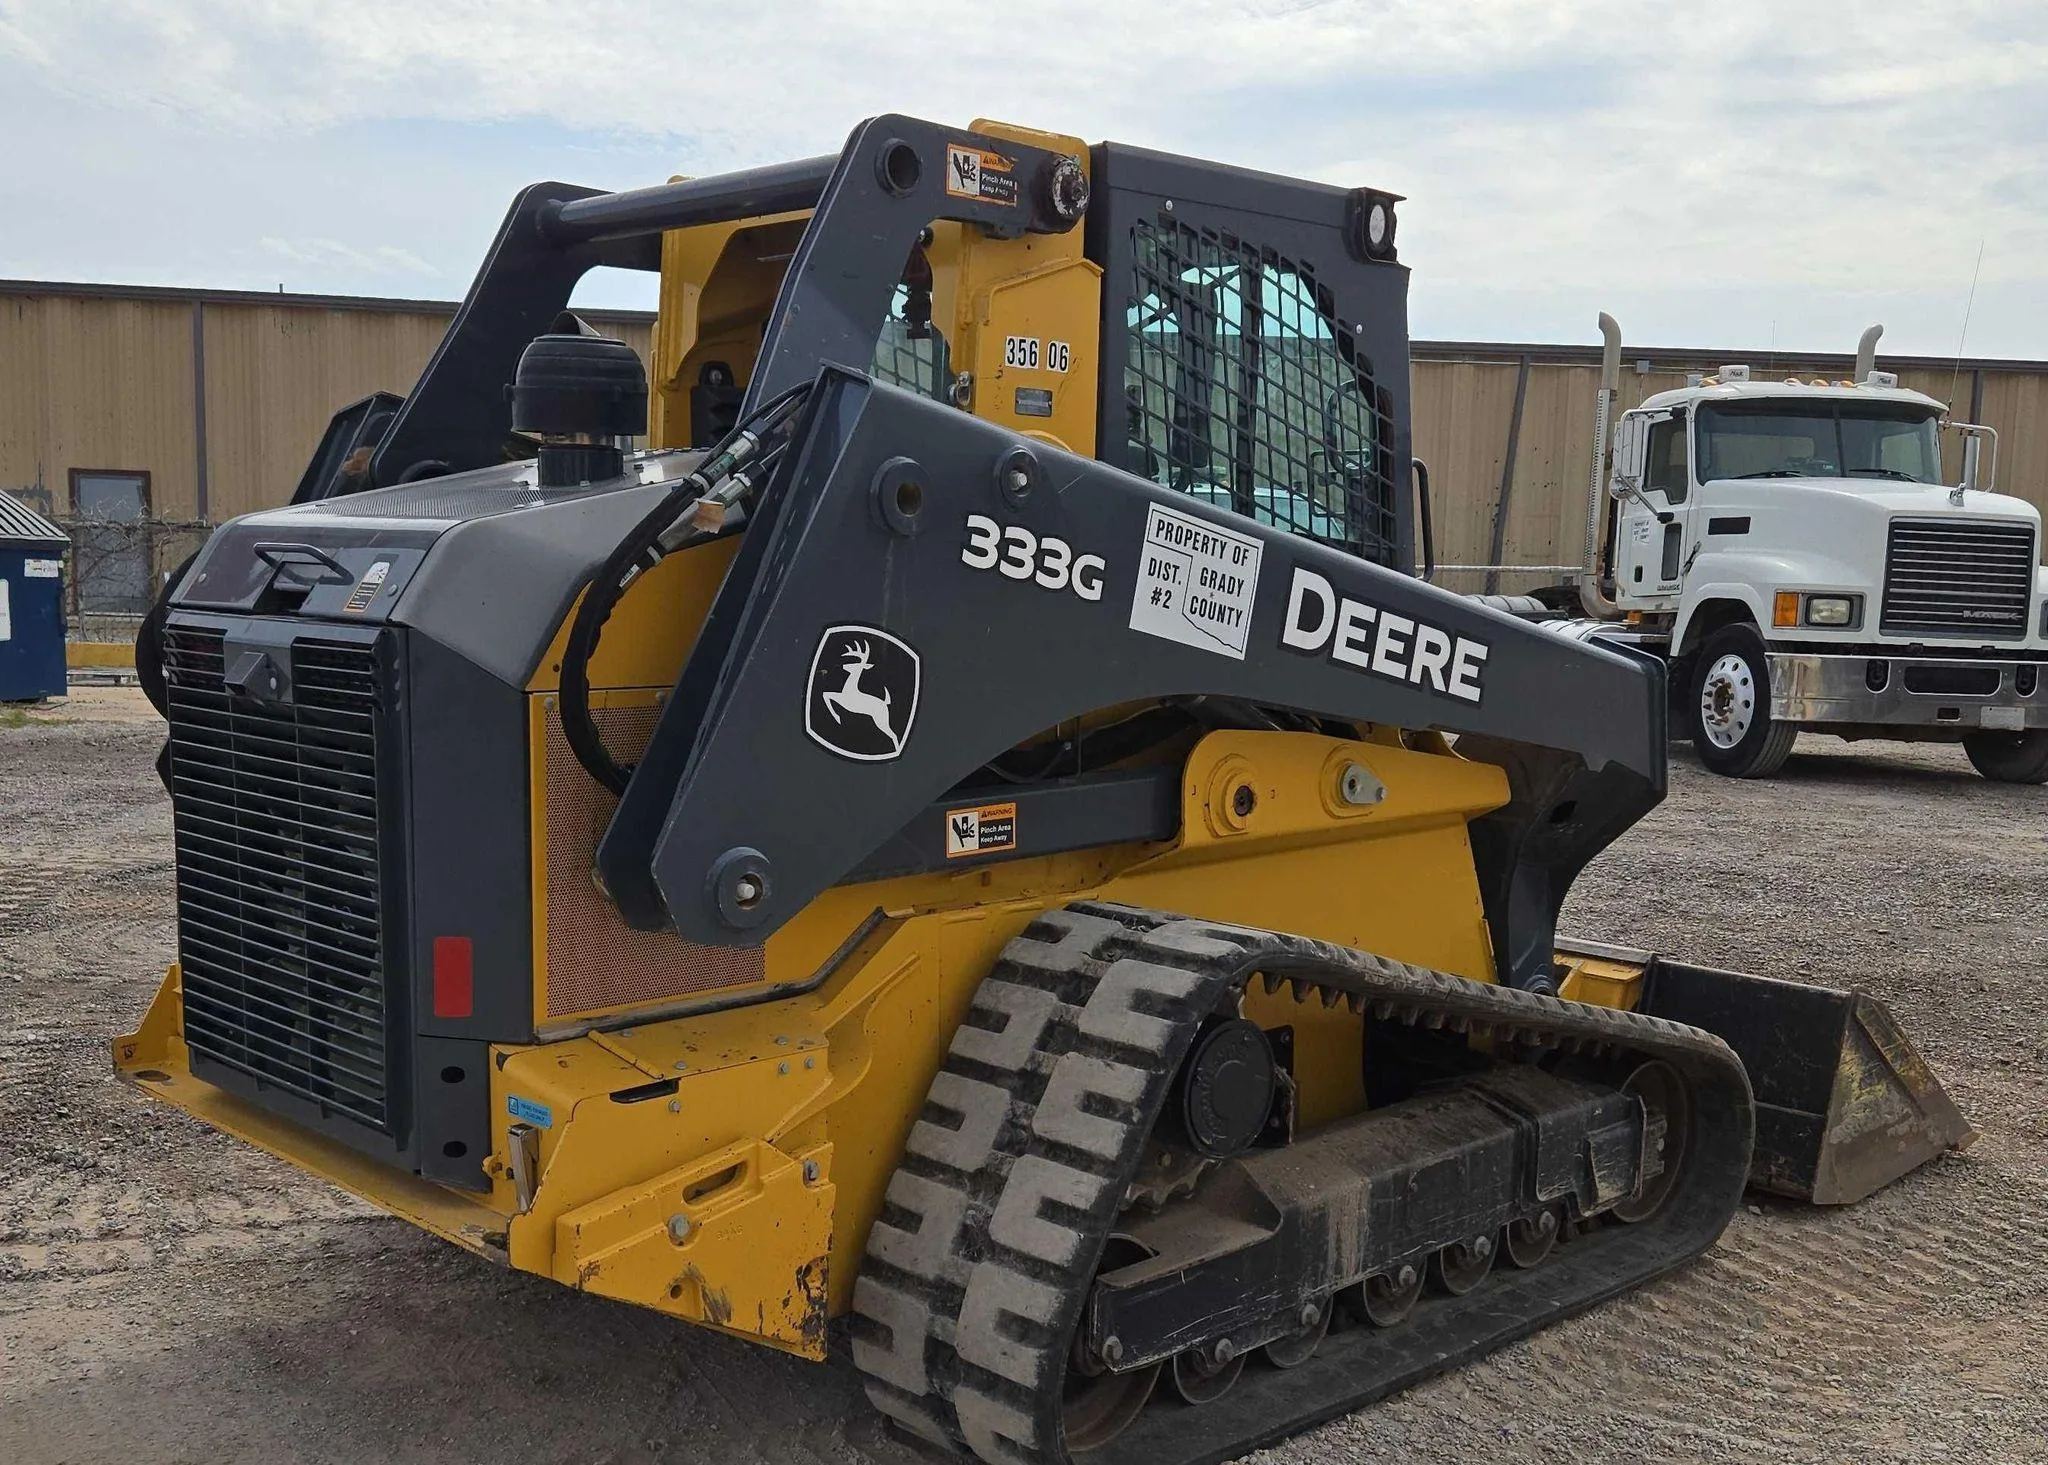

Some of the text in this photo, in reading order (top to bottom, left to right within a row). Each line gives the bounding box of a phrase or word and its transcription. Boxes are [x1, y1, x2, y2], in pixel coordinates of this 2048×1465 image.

[1007, 338, 1068, 371] 356 06
[962, 514, 1105, 601] 333G
[1155, 518, 1249, 567] PROPERTY OF
[1147, 557, 1245, 598] DIST. GRADY
[1150, 586, 1243, 628] #2 COUNTY
[1282, 567, 1488, 702] DEERE
[980, 824, 1011, 834] Pinch Area
